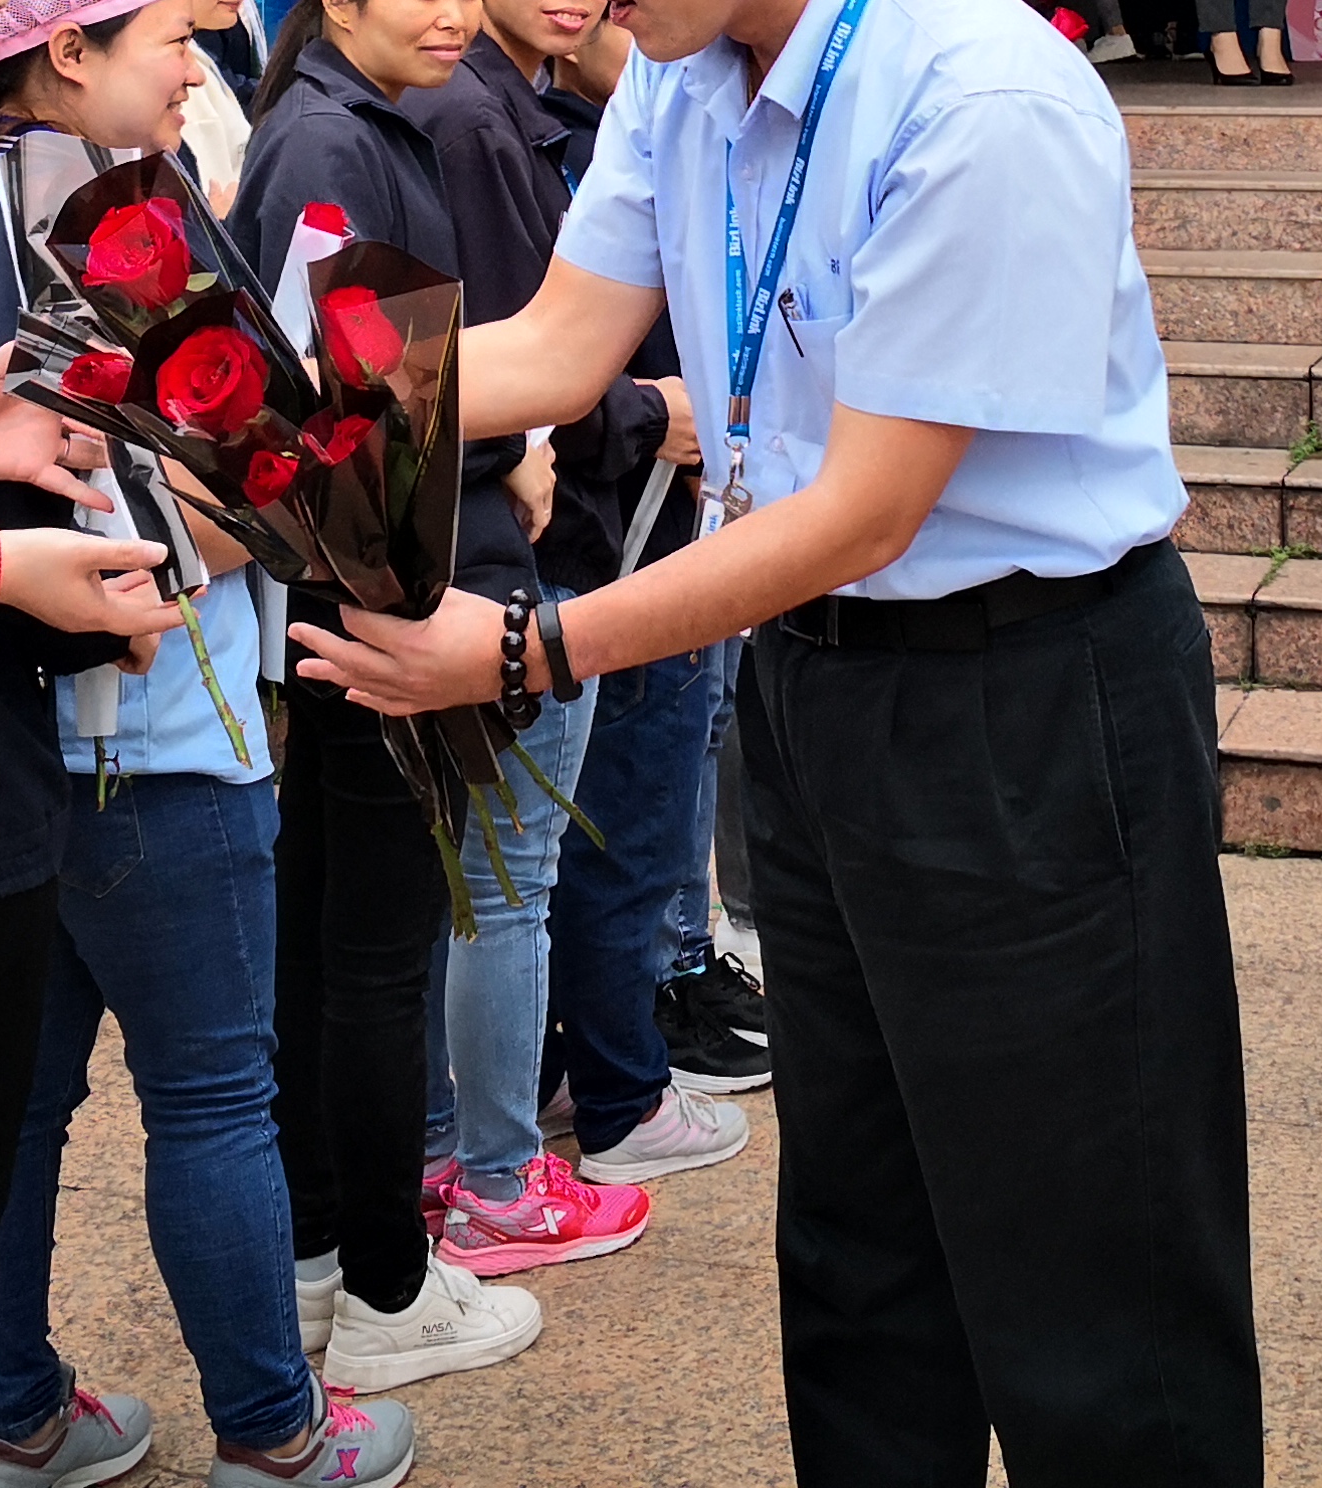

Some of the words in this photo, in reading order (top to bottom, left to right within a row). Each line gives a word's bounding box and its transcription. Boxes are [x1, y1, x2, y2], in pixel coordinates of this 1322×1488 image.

[820, 20, 853, 73] BizLink
[784, 155, 807, 206] BizLink
[746, 286, 771, 335] BizLink
[422, 1321, 454, 1334] NASA
